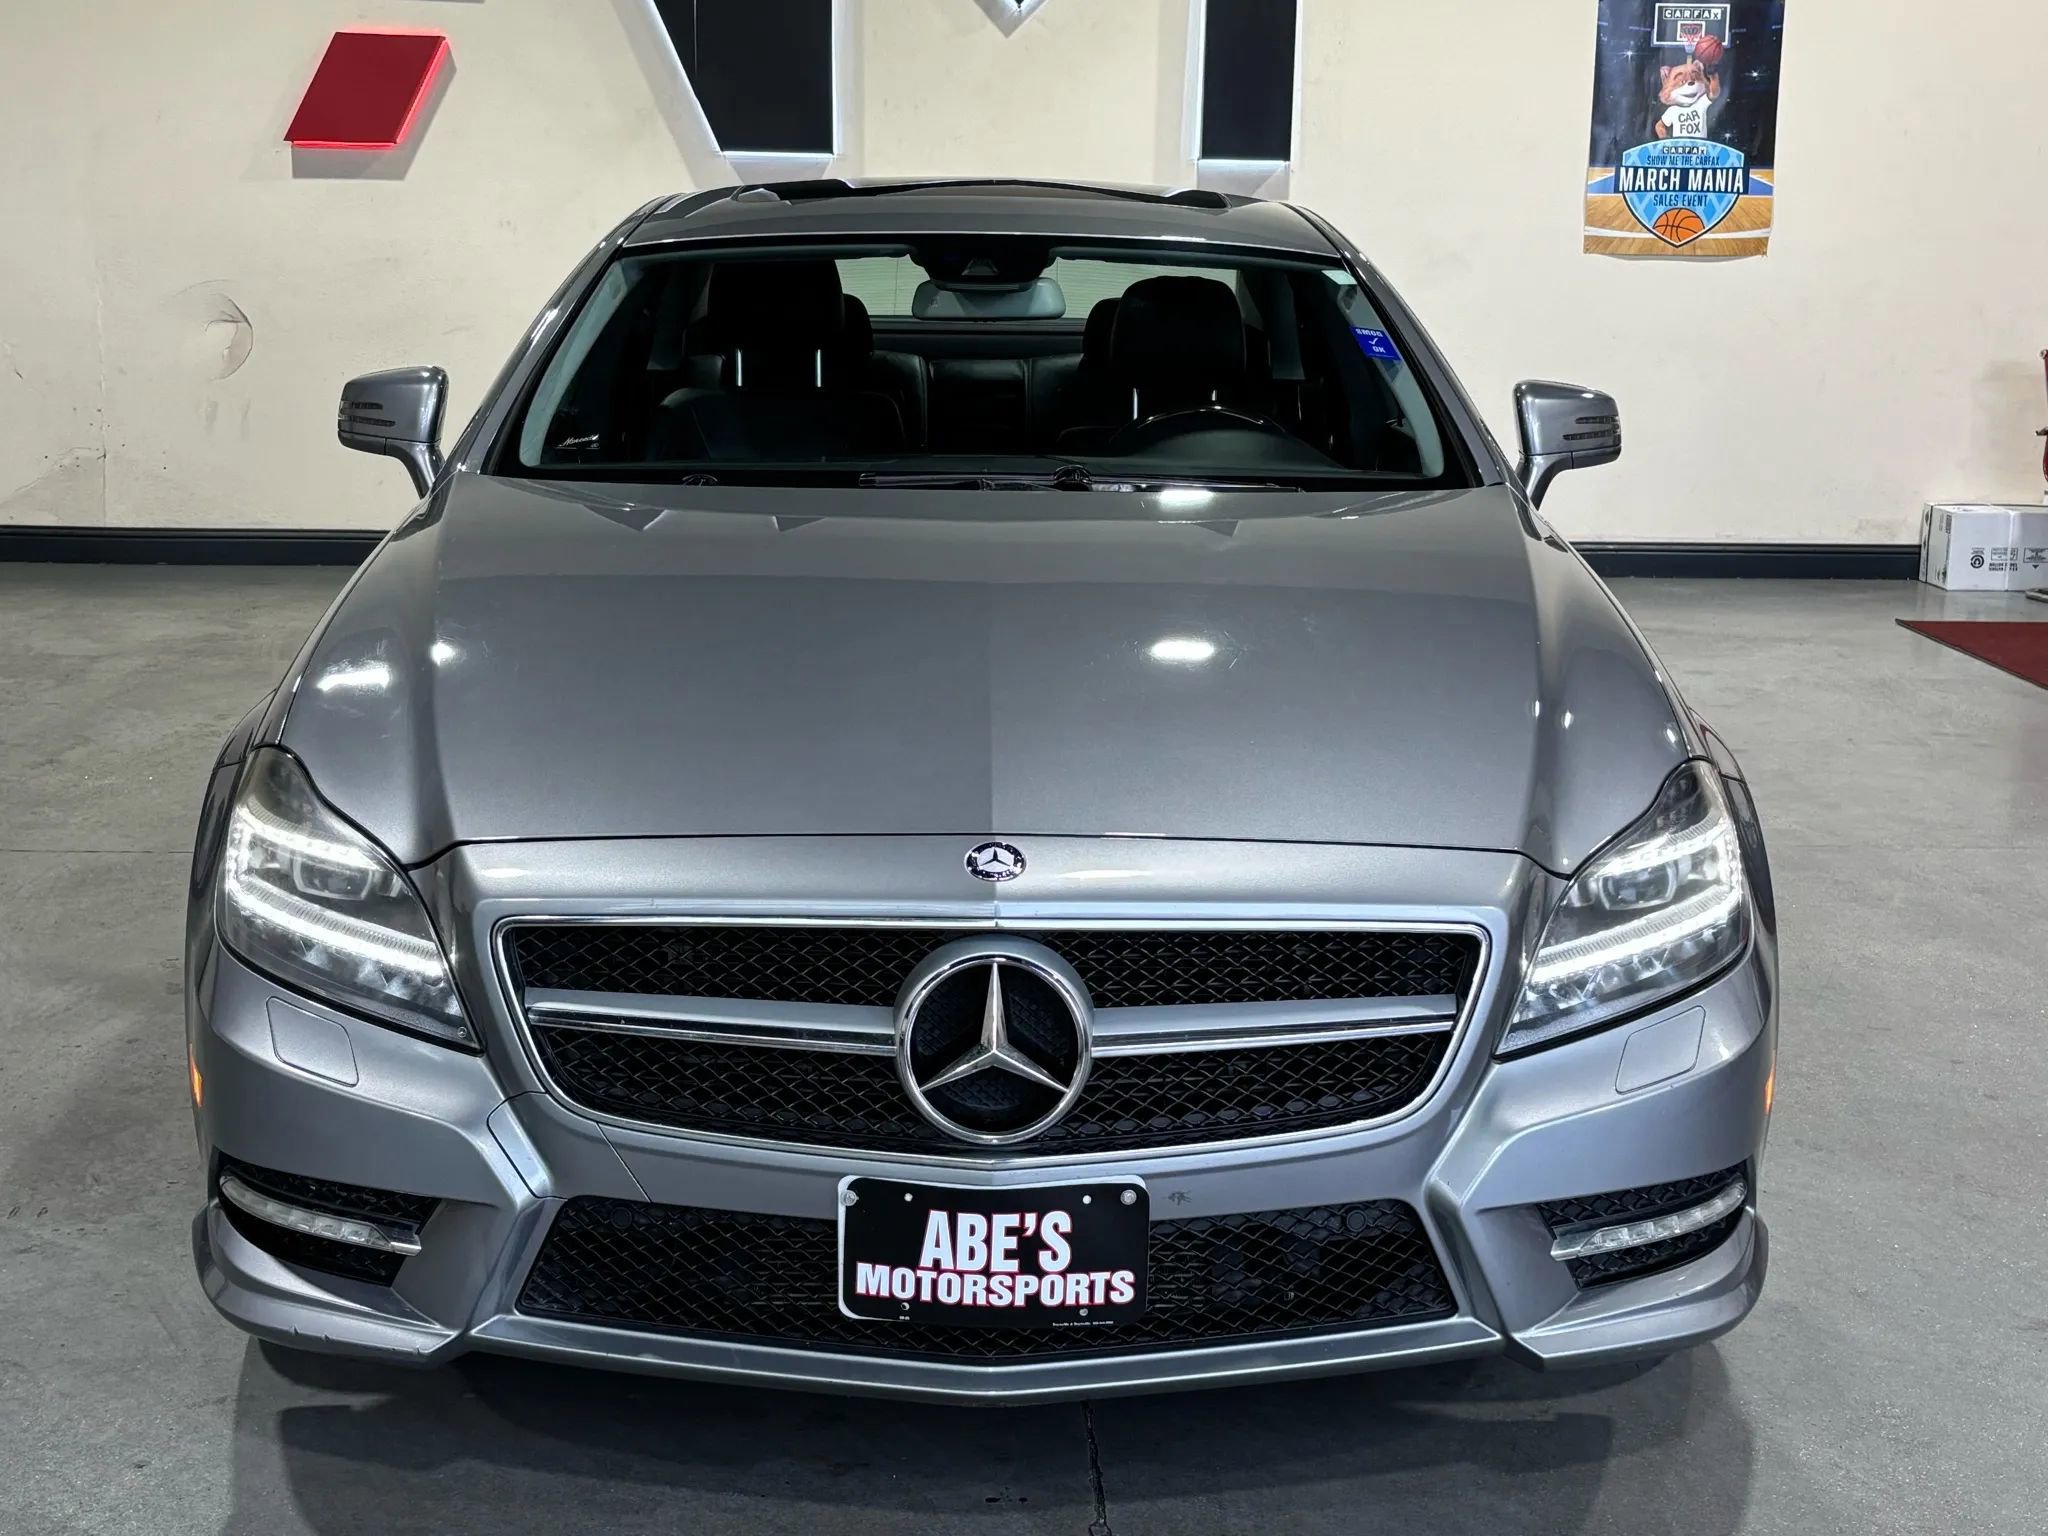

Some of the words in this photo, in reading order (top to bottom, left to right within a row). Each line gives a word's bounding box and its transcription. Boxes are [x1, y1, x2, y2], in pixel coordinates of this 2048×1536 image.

[1664, 8, 1721, 20] CARFAX
[1678, 110, 1700, 123] CAR
[1680, 122, 1701, 134] FOX
[1663, 146, 1707, 155] CARFAX
[1647, 155, 1667, 166] SHOW
[1669, 156, 1680, 166] ME
[1681, 156, 1694, 166] THE
[1695, 156, 1720, 166] CARFAX
[1618, 167, 1681, 192] MARCH
[1688, 168, 1744, 193] MANIA
[1653, 194, 1680, 207] SALES
[1683, 194, 1708, 207] EVENT
[919, 1209, 1072, 1272] ABE'S
[855, 1261, 1136, 1307] MOTORSPORTS
